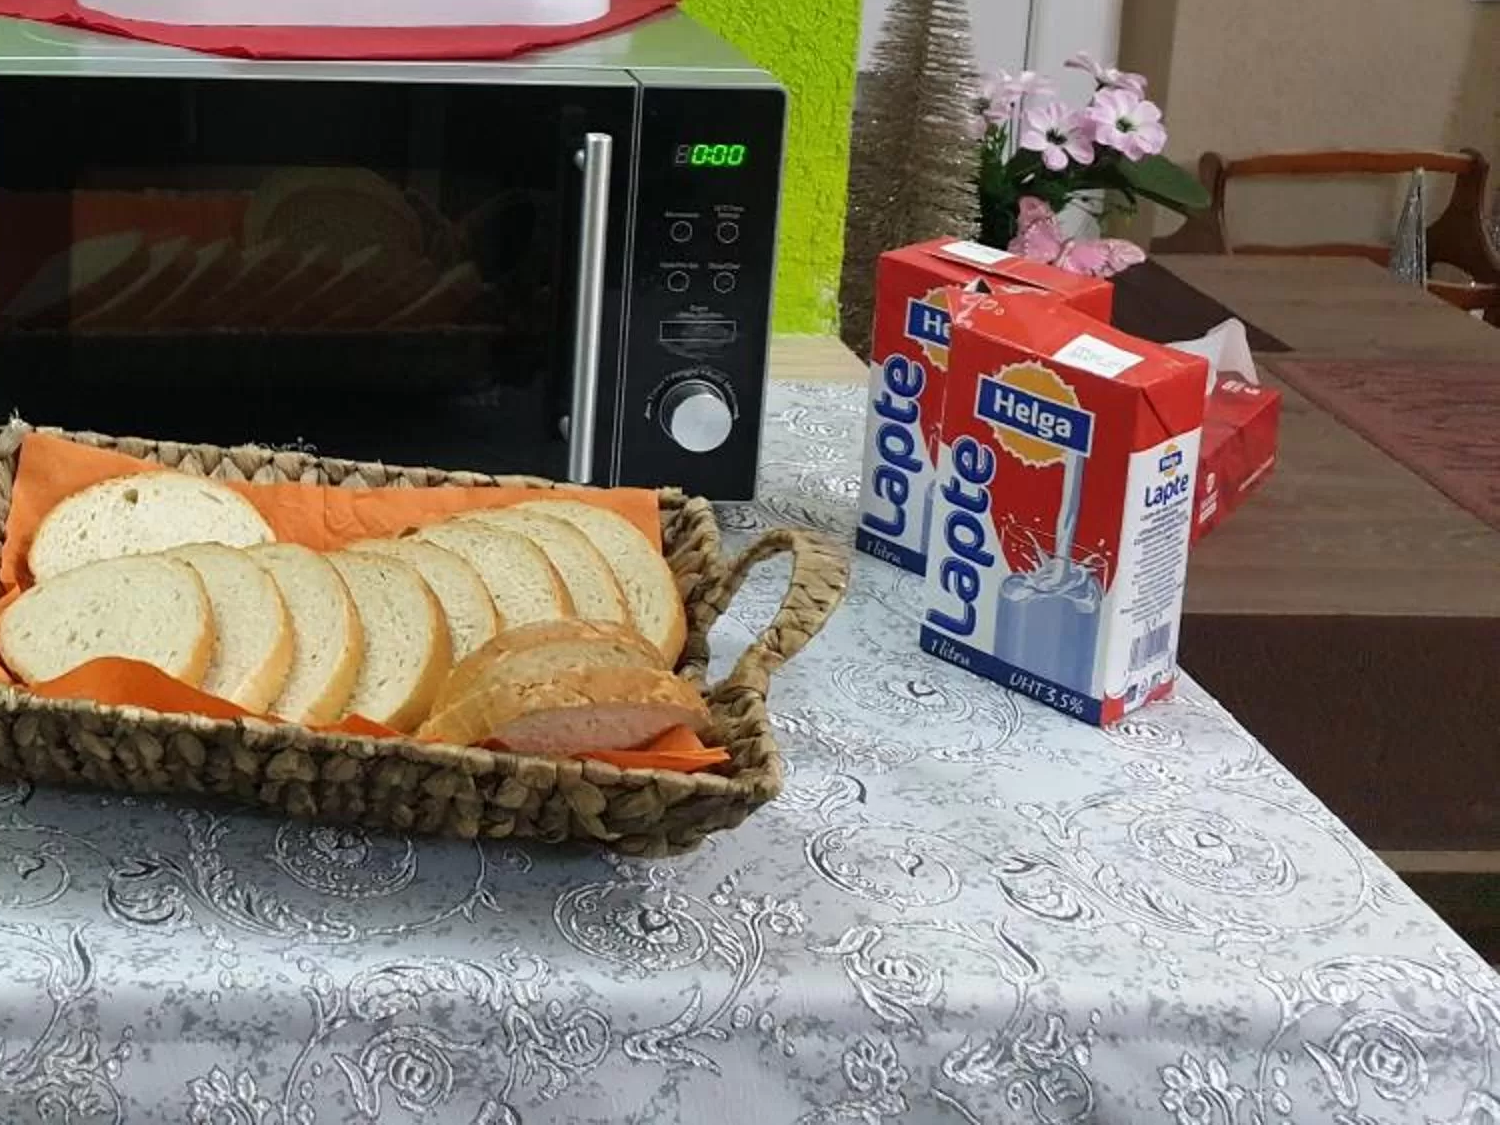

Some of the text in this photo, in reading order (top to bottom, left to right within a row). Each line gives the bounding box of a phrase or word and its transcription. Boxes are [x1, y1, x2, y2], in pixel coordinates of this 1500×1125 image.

[993, 388, 1072, 438] Helga
[861, 353, 925, 537] Lapte
[1145, 473, 1189, 507] Lapte
[925, 435, 996, 637] Lapte
[1009, 672, 1045, 698] UHT
